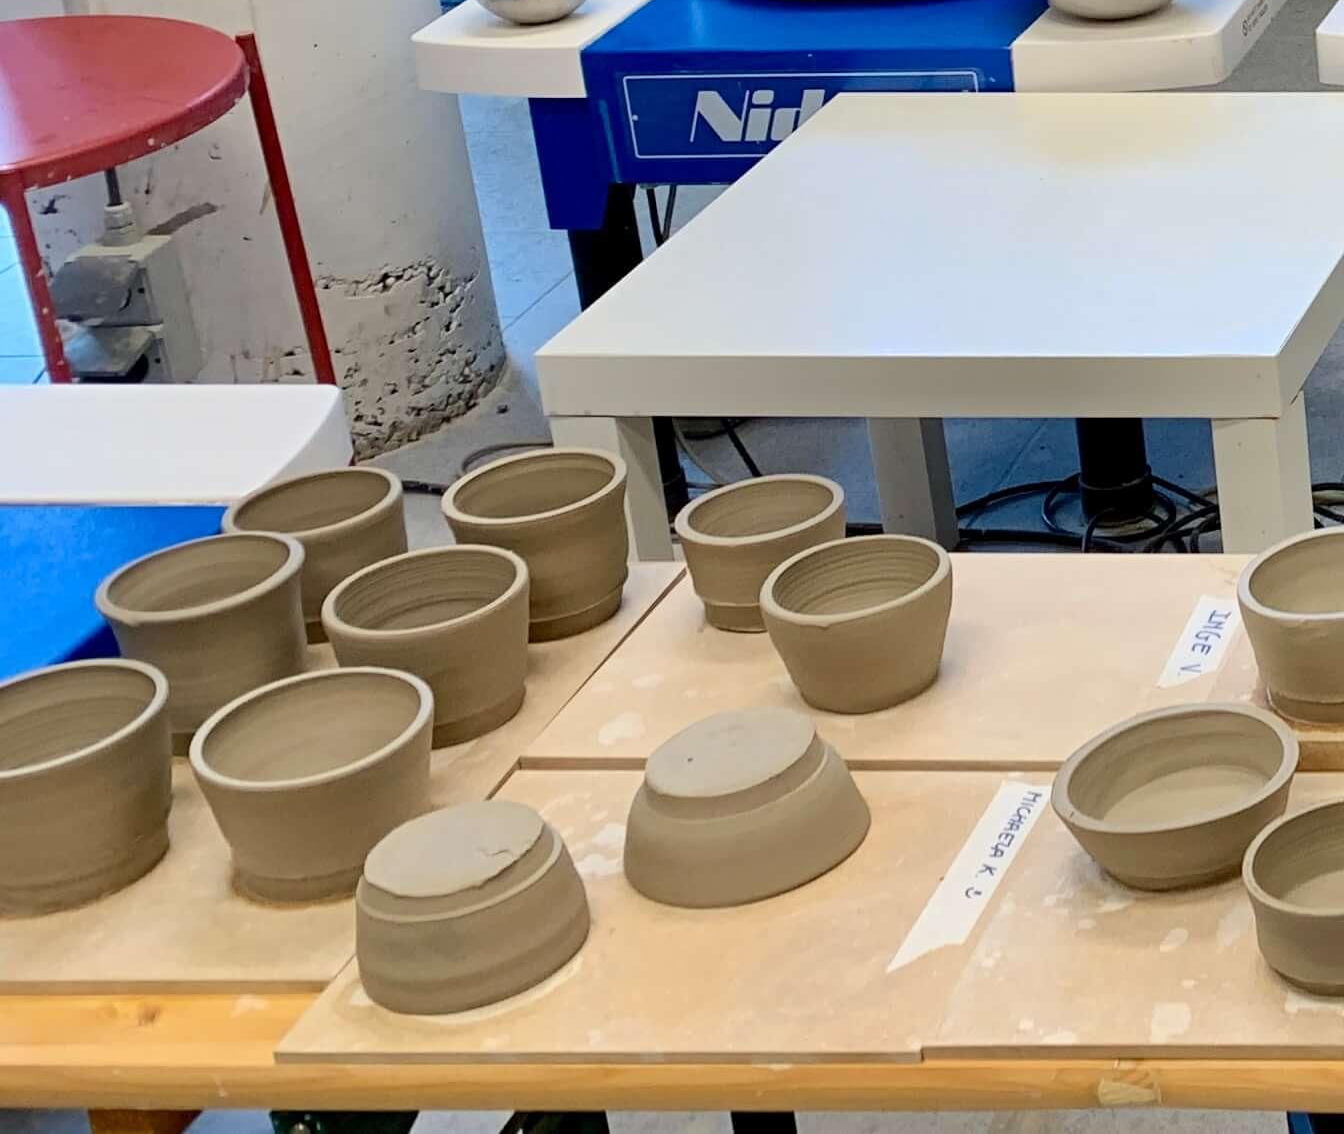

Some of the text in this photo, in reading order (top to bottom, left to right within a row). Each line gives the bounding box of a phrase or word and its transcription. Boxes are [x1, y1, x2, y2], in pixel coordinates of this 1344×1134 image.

[689, 88, 826, 143] Nid
[1176, 609, 1232, 677] INGE V.
[974, 790, 1043, 879] MICHAELA K.
